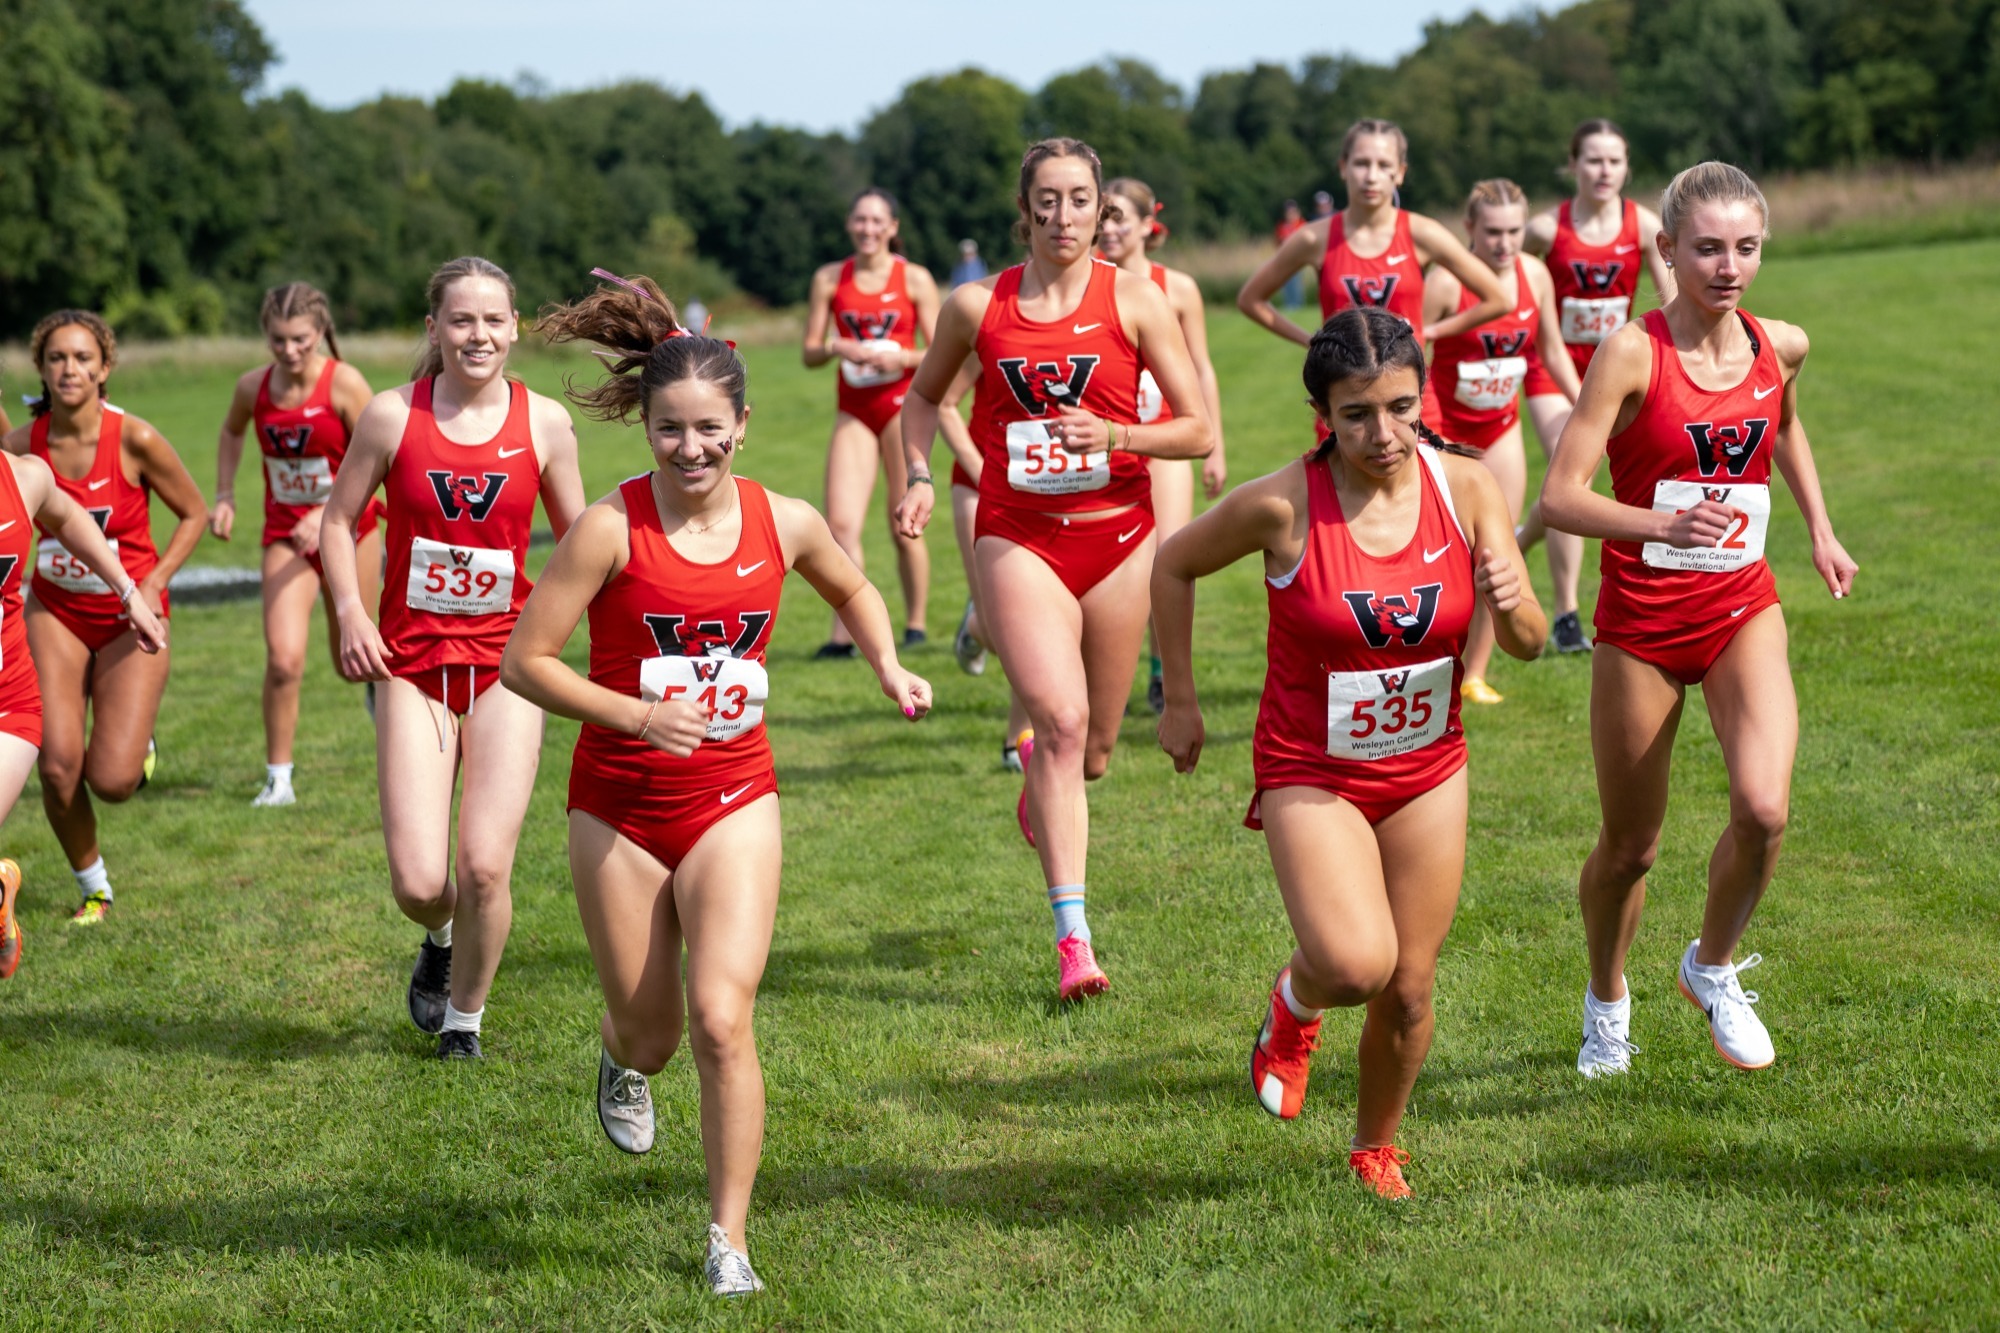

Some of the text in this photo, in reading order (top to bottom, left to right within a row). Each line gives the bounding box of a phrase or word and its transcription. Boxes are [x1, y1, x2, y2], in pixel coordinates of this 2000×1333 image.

[1568, 260, 1625, 294] W
[1339, 273, 1401, 309] W
[840, 309, 901, 342] W
[1572, 313, 1616, 333] 549
[1477, 328, 1530, 358] W
[997, 354, 1100, 416] W
[1469, 376, 1513, 396] 548
[263, 424, 314, 457] W
[1684, 418, 1769, 477] W
[1024, 443, 1093, 475] 551
[278, 470, 318, 494] 547
[1026, 475, 1092, 486] Wesleyan Cardinal
[1040, 484, 1080, 493] Invitational
[426, 470, 508, 522] W
[52, 553, 94, 579] 55
[449, 548, 475, 567] W
[1666, 549, 1742, 561] Wesleyan Cardinal
[1680, 561, 1726, 571] Invitational
[424, 562, 498, 598] 539
[425, 594, 493, 606] Wesleyan Cardinal
[438, 606, 479, 614] Invitational
[1343, 582, 1443, 648] W
[643, 610, 771, 660] W
[691, 659, 725, 682] W
[1377, 670, 1411, 694] W
[1349, 689, 1432, 739] 535
[706, 723, 741, 732] Cardinal
[1351, 728, 1429, 751] Wesleyan Cardinal
[1368, 743, 1414, 759] Invitational
